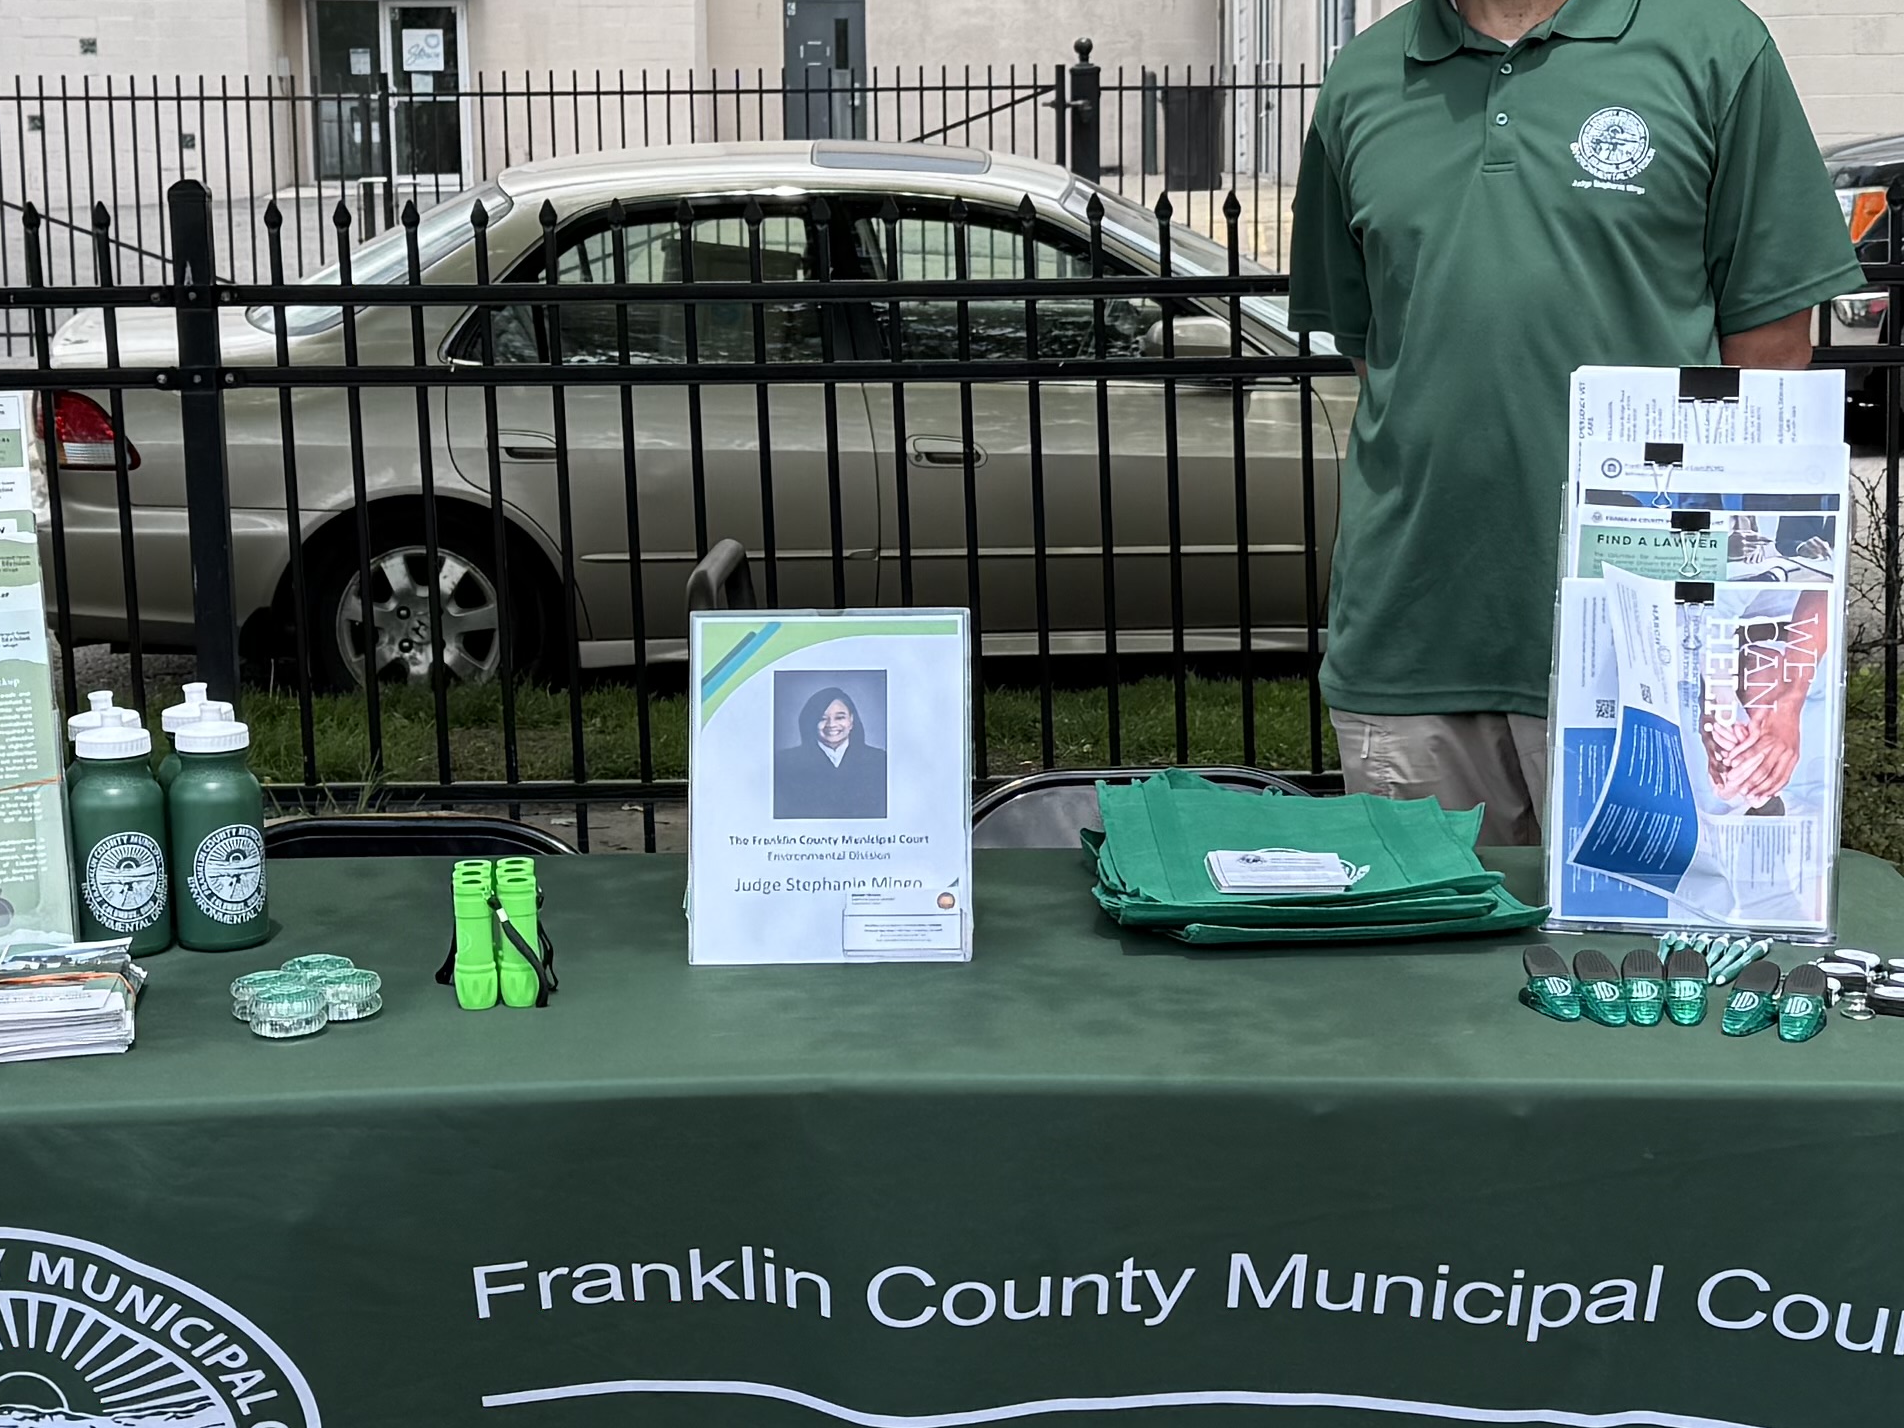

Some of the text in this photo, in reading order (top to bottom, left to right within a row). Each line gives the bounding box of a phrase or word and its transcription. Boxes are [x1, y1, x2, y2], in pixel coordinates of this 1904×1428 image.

[1596, 534, 1632, 546] FIND
[1638, 538, 1648, 547] A
[1744, 618, 1779, 713] CAN
[1783, 613, 1819, 683] WE
[1704, 615, 1740, 732] HELP.
[94, 836, 128, 859] COUNTY
[203, 828, 237, 853] COUNTY
[729, 835, 749, 846] The
[752, 834, 797, 846] Franklin
[799, 835, 839, 848] County
[899, 834, 930, 845] Court
[734, 877, 781, 894] Judge
[472, 1245, 832, 1319] Franklin
[865, 1256, 1196, 1329] County
[1225, 1252, 1665, 1343] Municipal
[27, 1250, 280, 1417] MUNICIPAL
